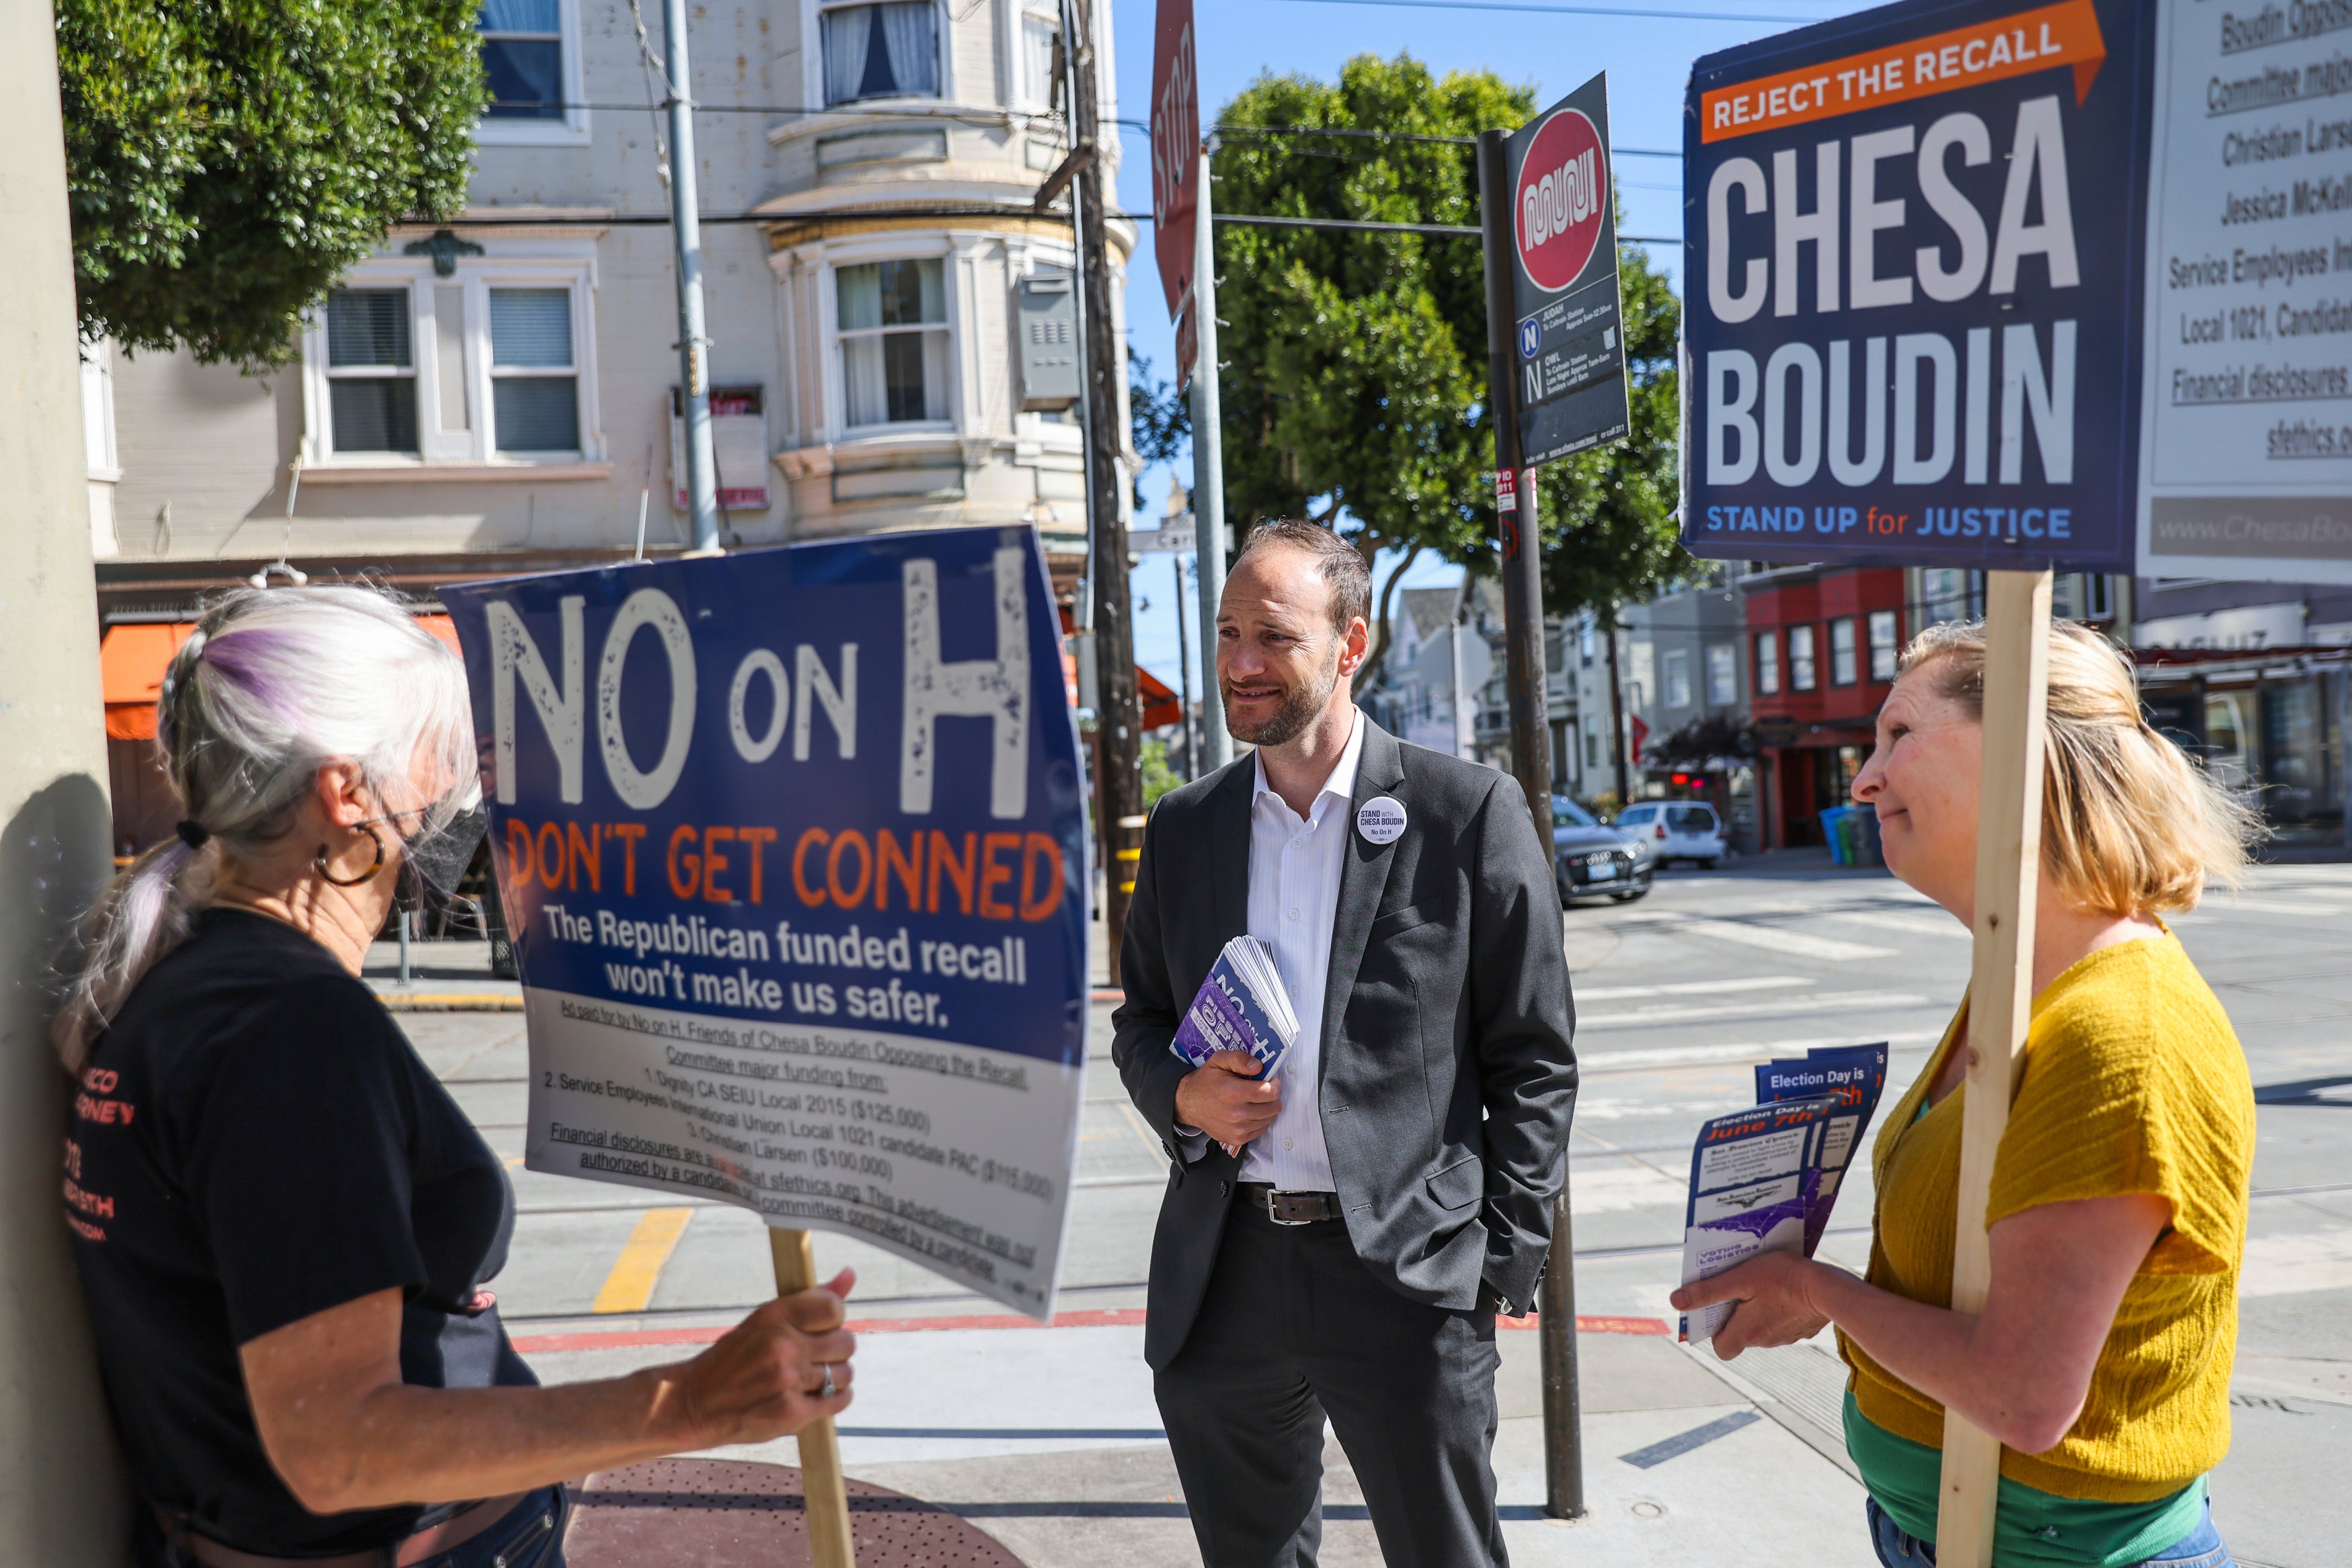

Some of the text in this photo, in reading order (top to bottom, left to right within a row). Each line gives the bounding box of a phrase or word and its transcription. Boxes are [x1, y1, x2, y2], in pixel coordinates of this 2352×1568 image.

[1714, 23, 2061, 128] REJECT THE RECALL
[1153, 21, 1192, 230] STOP
[1707, 94, 2080, 324] CHESA
[2169, 244, 2328, 290] Service Employees
[1543, 303, 1564, 322] JUDAH
[2181, 309, 2224, 344] Local
[1524, 324, 1537, 353] N
[1545, 352, 1561, 367] OWL
[1525, 360, 1543, 404] N
[2173, 360, 2349, 401] Financial disclosures
[1707, 319, 2077, 487] BOUDIN
[1707, 505, 2071, 538] STAND UP for JUSTICE
[485, 546, 1031, 819] NO ON H
[1361, 810, 1380, 818] STAND
[1381, 817, 1404, 825] BOUDIN
[507, 819, 1065, 922] DON'T GET CONNED
[543, 905, 1026, 985] The Republican funded recall
[604, 962, 949, 1027] won't make us safer.
[633, 1012, 650, 1033] No
[688, 1021, 737, 1045] Friends
[758, 1030, 809, 1053] Chesa
[813, 1034, 871, 1059] Boudin
[1250, 1038, 1276, 1064] H
[666, 1044, 734, 1073] Committee
[1877, 1052, 1884, 1063] is
[1771, 1067, 1864, 1088] Election Day is
[544, 1071, 557, 1088] 2.
[559, 1073, 604, 1095] Service
[606, 1080, 669, 1109] Employees
[742, 1113, 786, 1135] Union
[790, 1118, 834, 1141] Local
[838, 1124, 874, 1147] 1021
[697, 1079, 718, 1099] CA
[720, 1083, 756, 1106] SEIU
[760, 1089, 801, 1110] Local
[807, 1094, 846, 1116] 2015
[1706, 1111, 1813, 1141] June 7th
[1712, 1110, 1772, 1128] Election
[1775, 1105, 1804, 1115] Day
[550, 1121, 607, 1146] Financial
[610, 1132, 681, 1160] disclosures
[755, 1142, 808, 1164] Larsen
[580, 1151, 649, 1176] authorized
[652, 1161, 668, 1181] by
[762, 1195, 845, 1218] committee
[1699, 1243, 1760, 1265] LOGISTICS
[1700, 1243, 1742, 1258] VOTING
